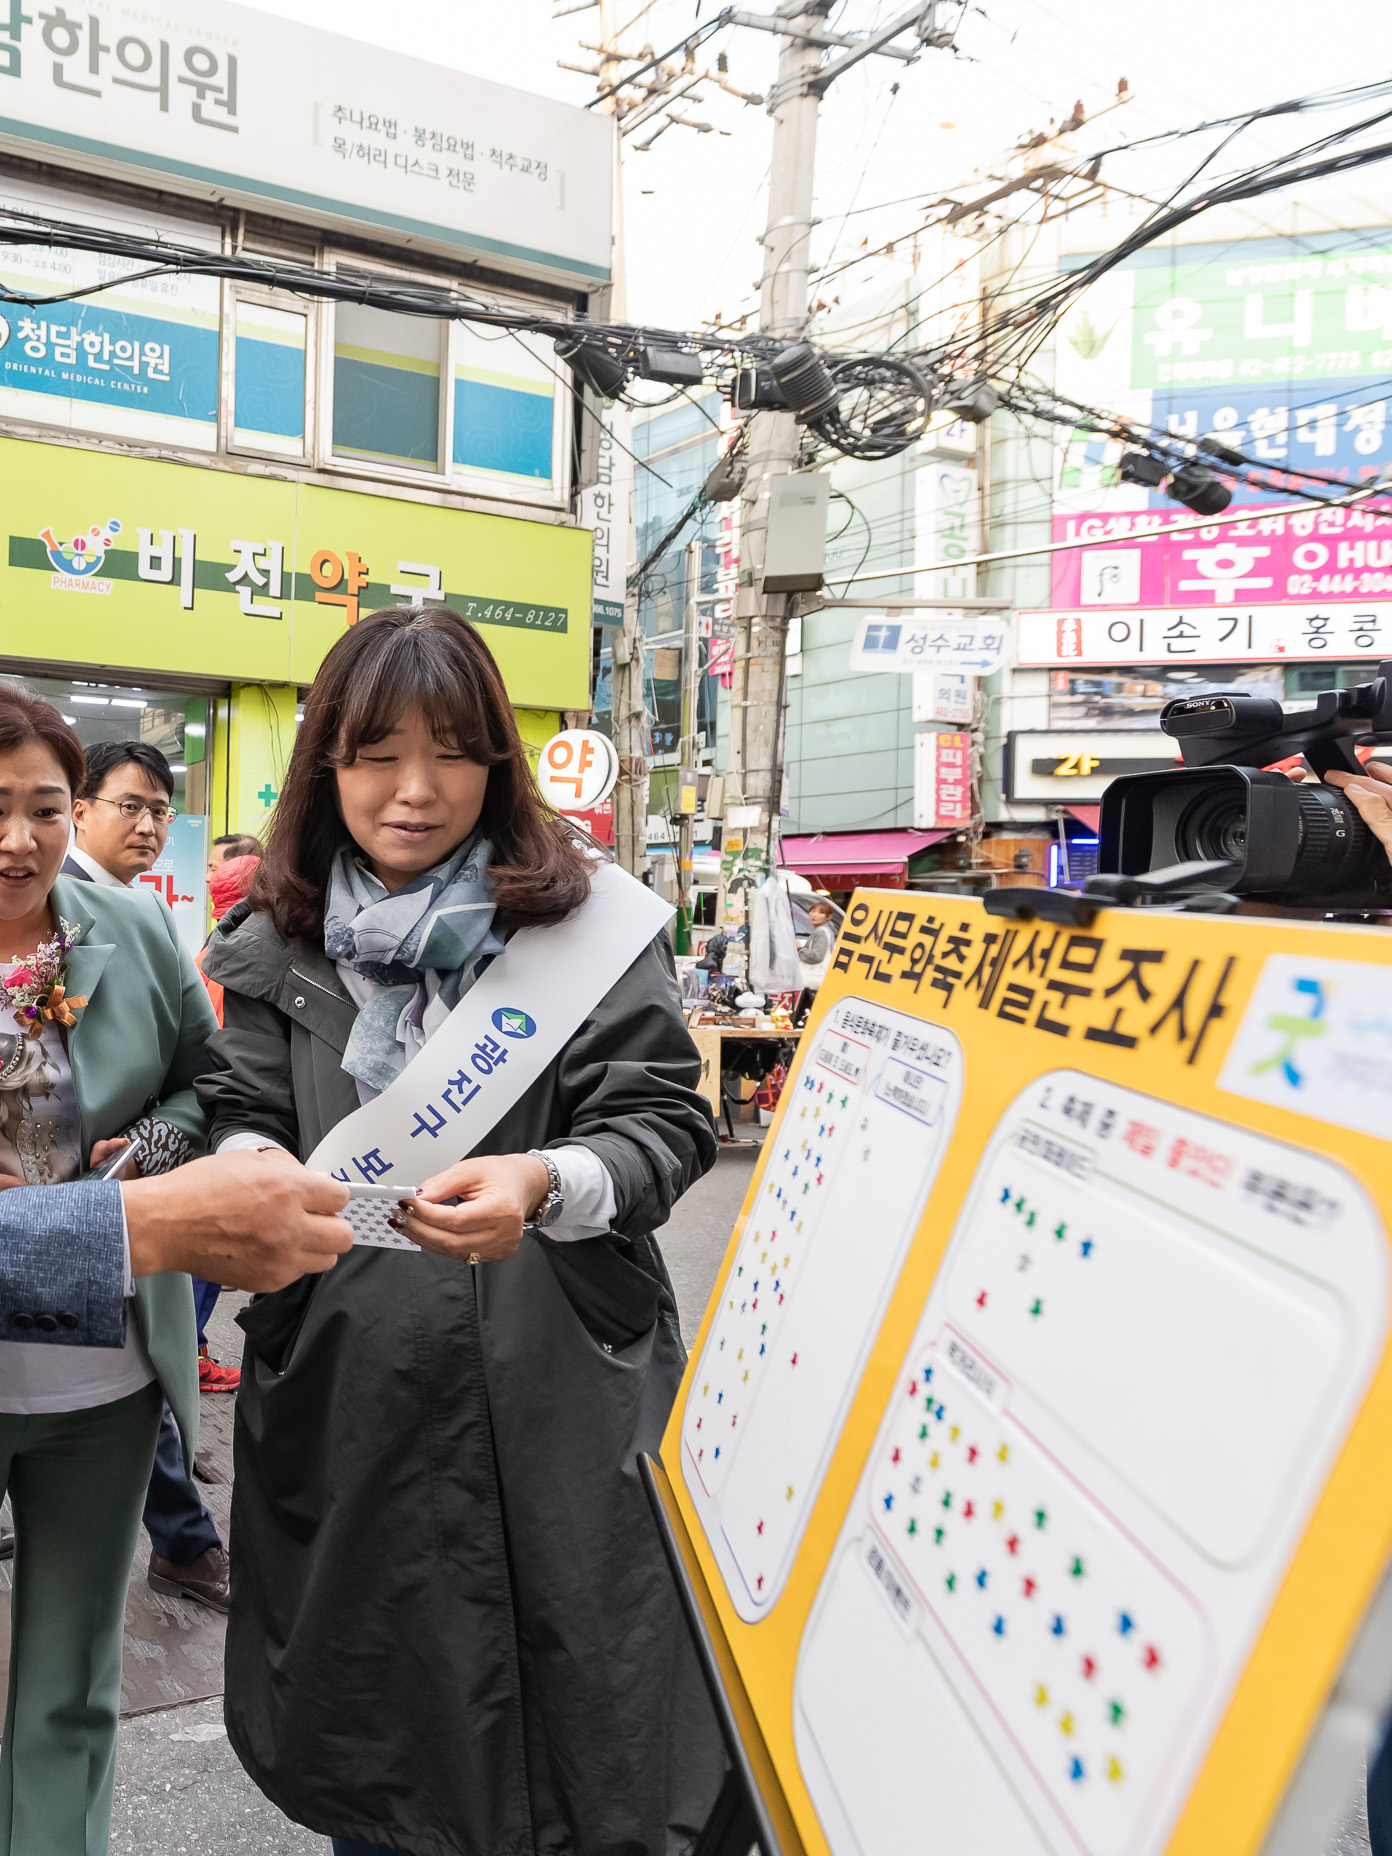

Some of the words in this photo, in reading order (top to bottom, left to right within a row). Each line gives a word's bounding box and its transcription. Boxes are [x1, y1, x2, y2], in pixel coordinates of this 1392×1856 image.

[332, 103, 398, 141] 추나요법
[413, 125, 475, 162] 봉침요법
[489, 146, 549, 183] 척추교정
[394, 153, 442, 181] 디스크
[446, 166, 477, 193] 전문
[50, 260, 72, 275] 4:00
[16, 316, 171, 382] 청담한의원
[4, 361, 56, 379] ORIENTAL
[61, 372, 107, 388] MEDICAL
[110, 380, 150, 395] CENTER
[52, 576, 112, 594] PHARMACY
[1177, 541, 1274, 603] 후
[465, 601, 566, 628] T.464-8127
[905, 633, 1005, 656] 성수교회
[1186, 699, 1211, 709] SONY
[938, 733, 965, 748] CL
[547, 739, 595, 799] 약
[1054, 752, 1101, 777] 2F
[1335, 829, 1346, 838] G
[409, 1033, 510, 1140] 광진구
